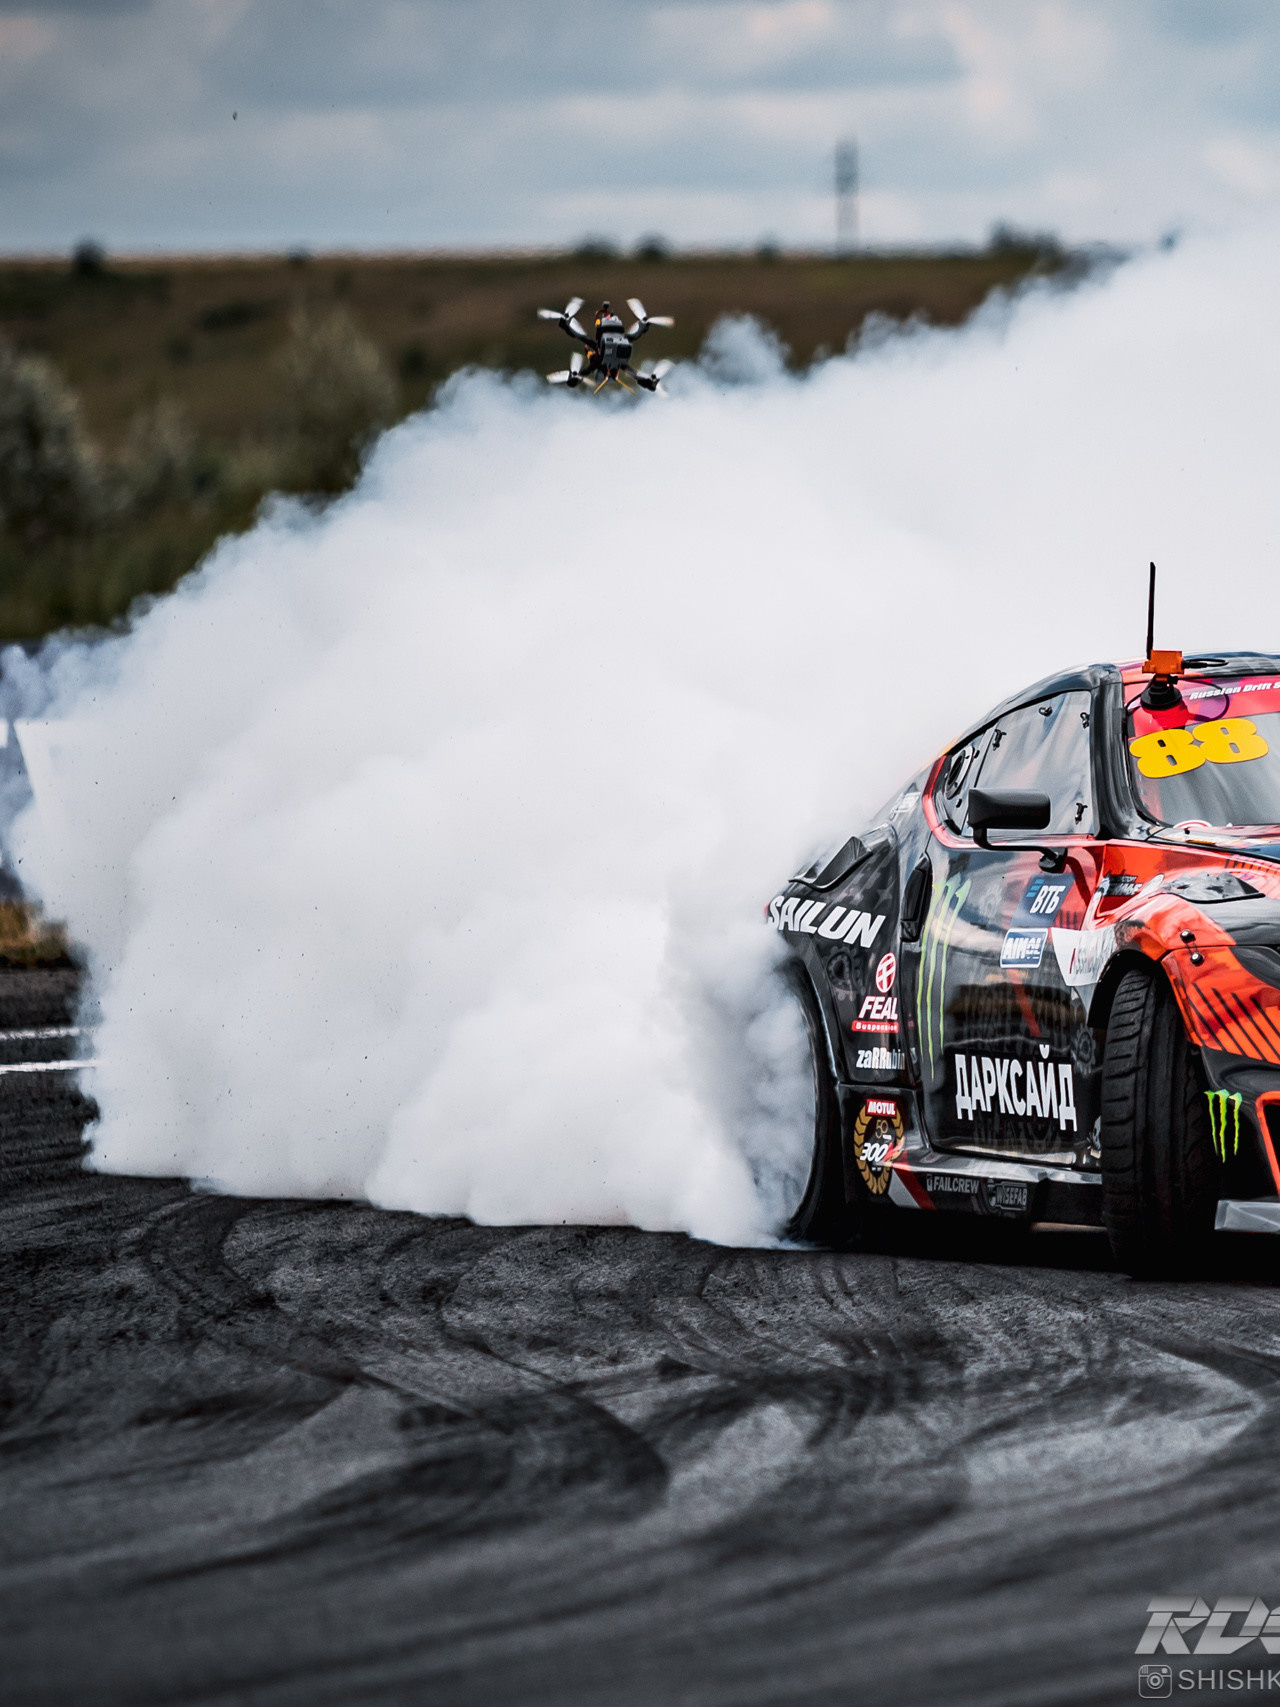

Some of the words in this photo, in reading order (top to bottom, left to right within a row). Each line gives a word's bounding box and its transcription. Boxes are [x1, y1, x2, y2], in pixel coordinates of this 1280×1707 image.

[1189, 685, 1242, 700] Russian
[1243, 681, 1272, 692] Drift
[1129, 718, 1269, 778] 88
[769, 896, 886, 948] SAILUN
[858, 996, 898, 1019] FEAL
[955, 1044, 1077, 1131] ДАРКСАЙД
[867, 1101, 896, 1115] MOTUL
[875, 1119, 888, 1139] 50
[933, 1176, 979, 1194] FAILCREW
